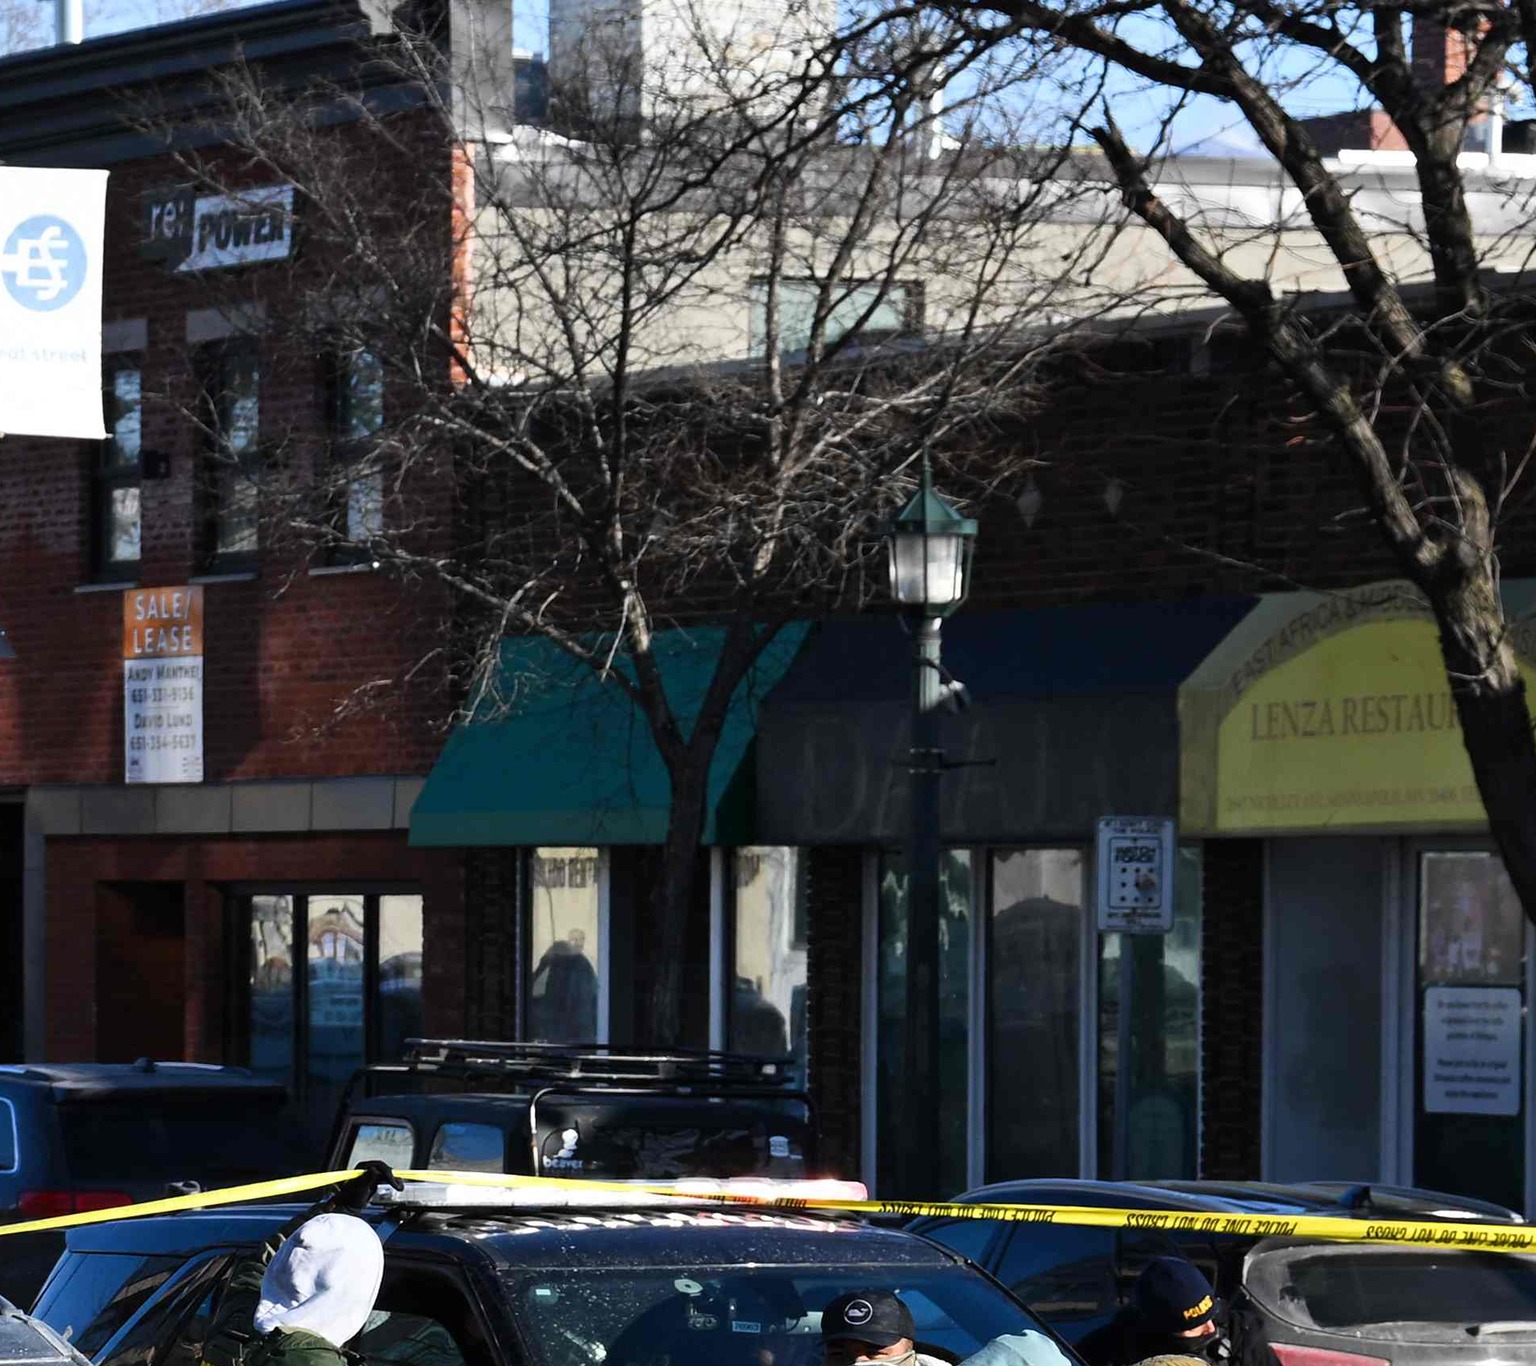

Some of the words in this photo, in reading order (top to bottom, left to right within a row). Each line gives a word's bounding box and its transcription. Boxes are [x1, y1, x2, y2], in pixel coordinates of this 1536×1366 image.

[135, 591, 193, 621] SALE/
[133, 625, 194, 654] LEASE
[1251, 700, 1335, 740] LENZA
[1342, 692, 1463, 736] RESTAUR
[542, 1155, 583, 1169] beaver
[1125, 1212, 1169, 1229] CROSS
[1171, 1215, 1196, 1229] NOT
[1201, 1216, 1223, 1231] DO
[1223, 1218, 1251, 1233] LINE
[1252, 1220, 1298, 1235] POLICE
[1363, 1225, 1407, 1240] CROSS
[1410, 1227, 1436, 1241] NOT
[1440, 1230, 1457, 1242] DO
[1461, 1231, 1489, 1244] LINE
[1490, 1233, 1533, 1248] POLICE
[1183, 1295, 1213, 1320] POLICE
